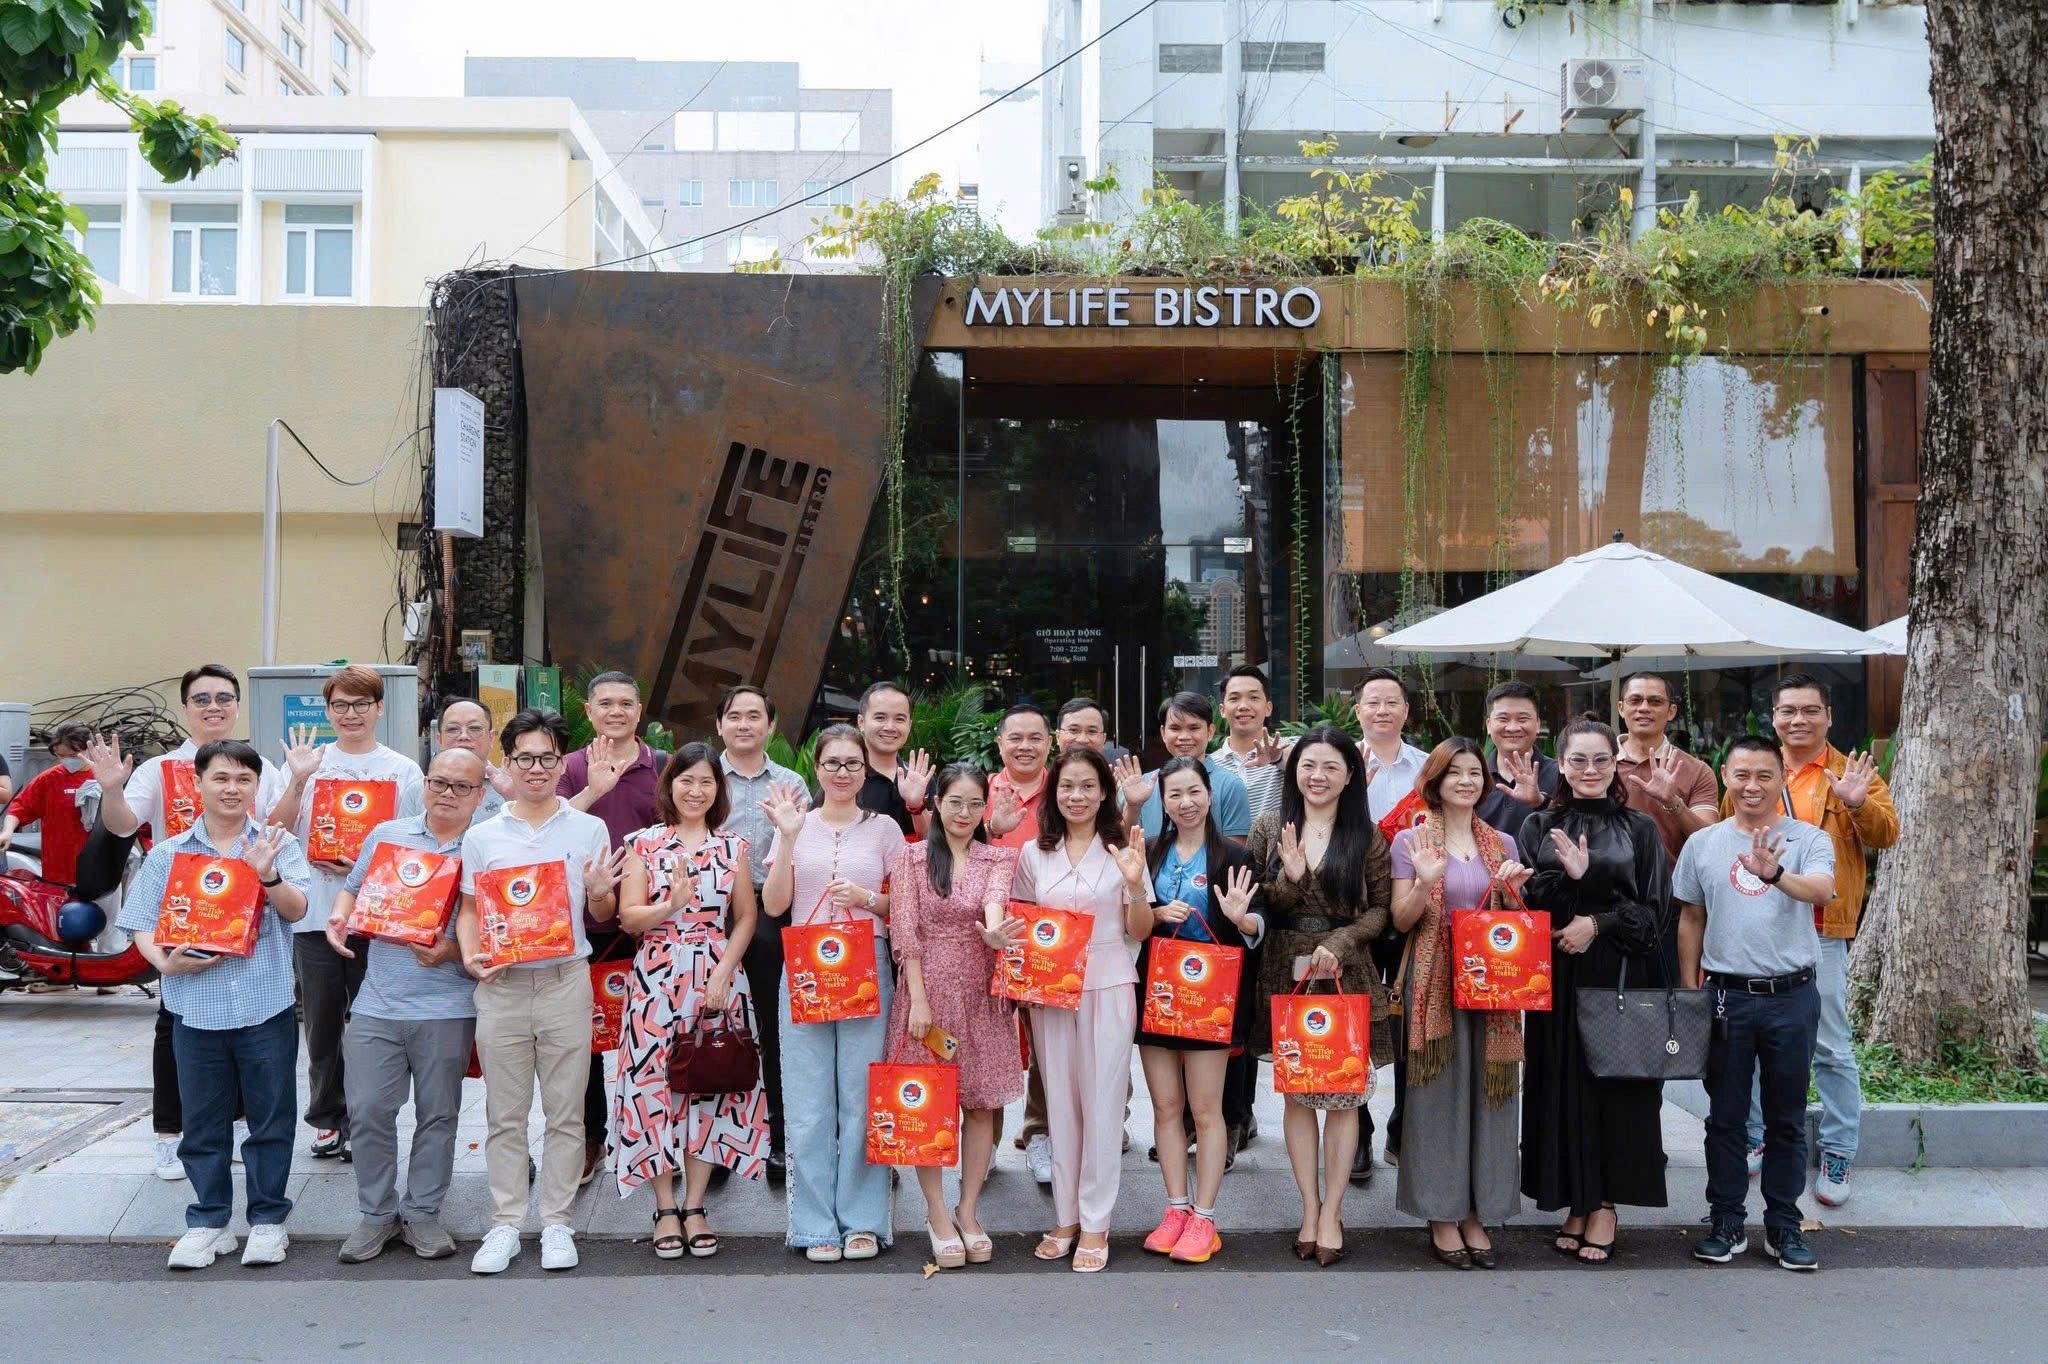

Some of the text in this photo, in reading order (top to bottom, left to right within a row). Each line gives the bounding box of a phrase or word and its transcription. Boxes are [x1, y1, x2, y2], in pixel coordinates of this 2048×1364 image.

[965, 286, 1322, 328] MYLIFE BISTRO
[794, 469, 832, 556] BISTRO
